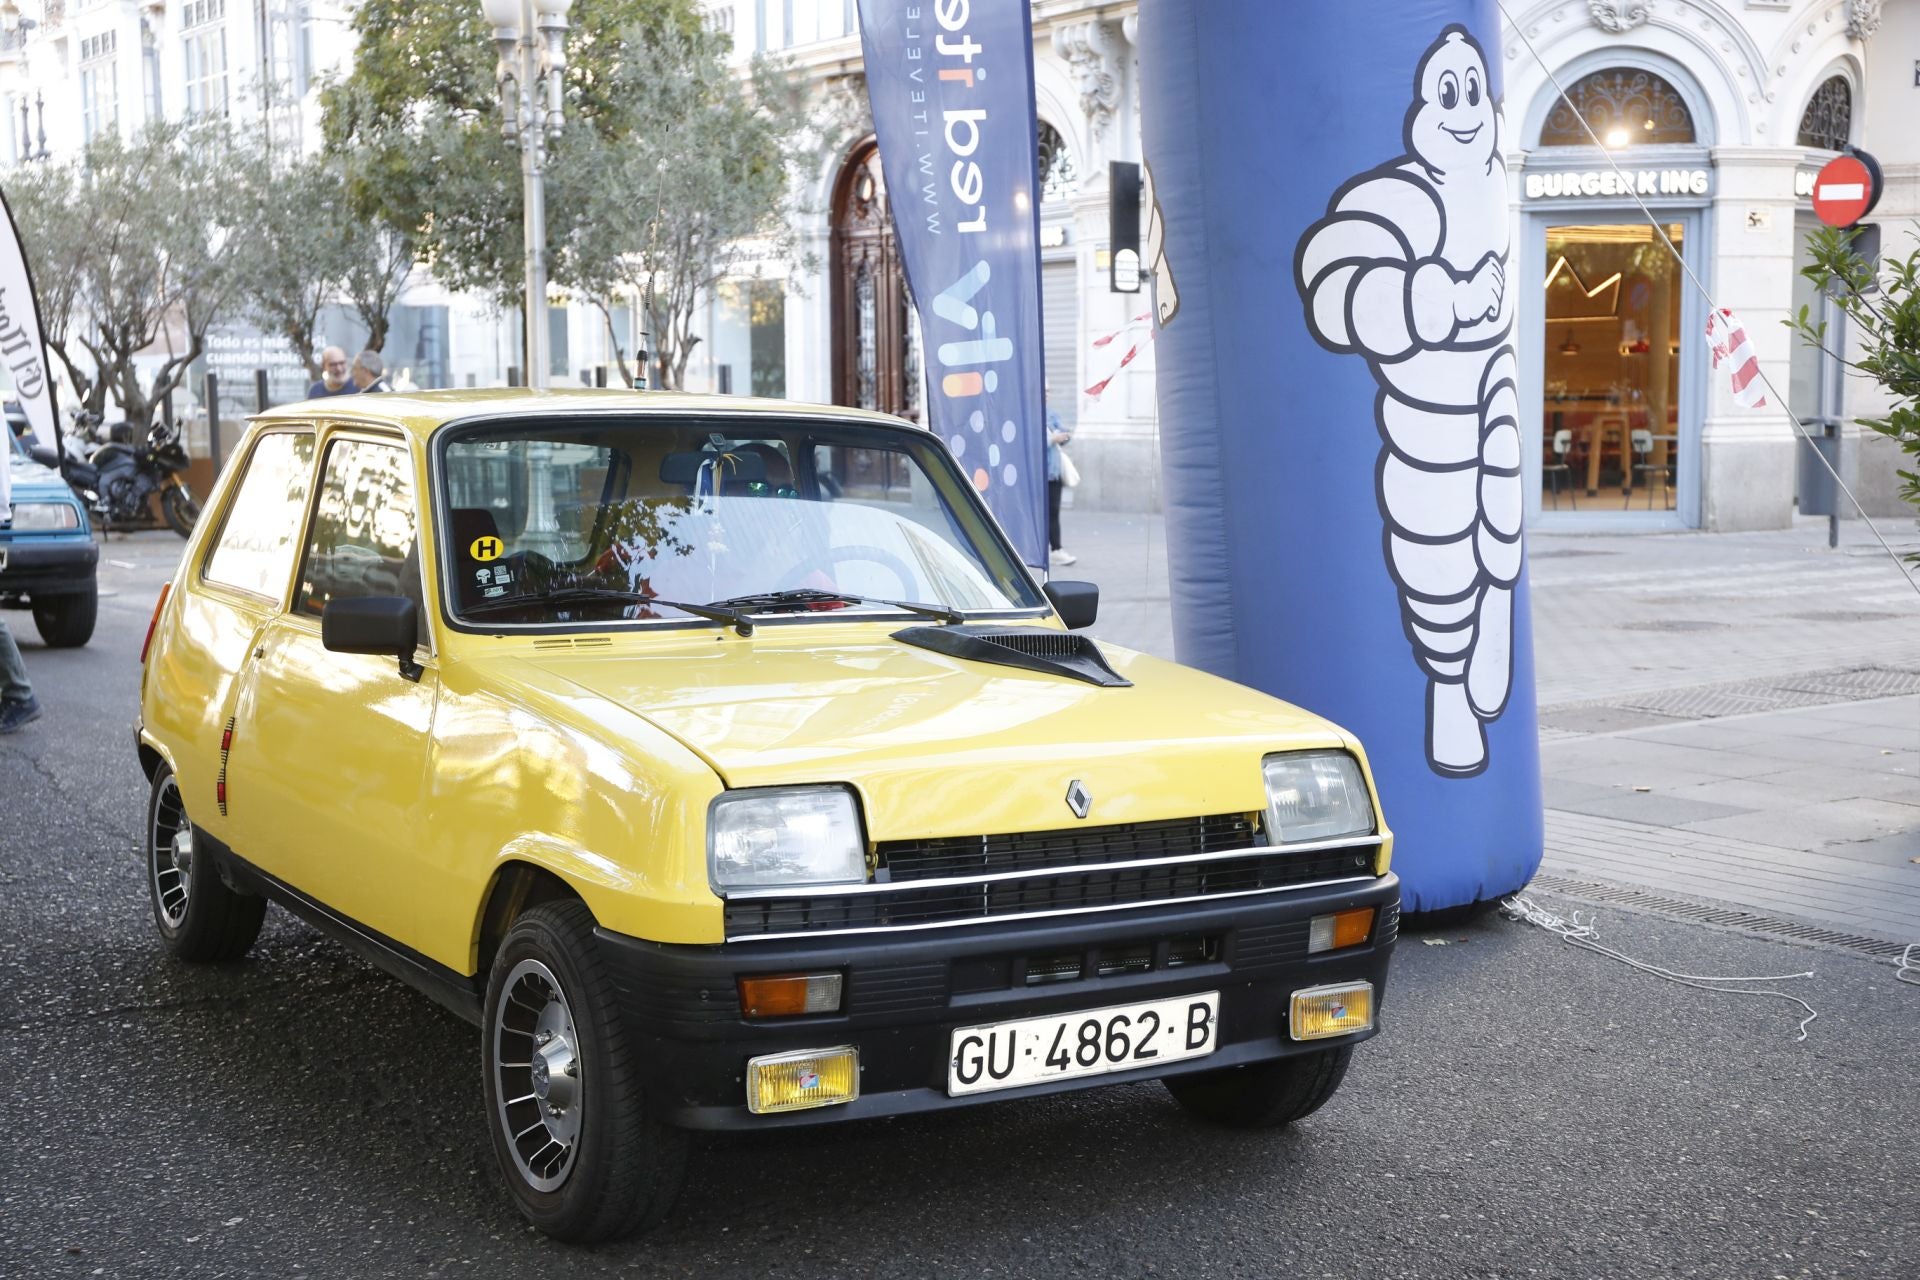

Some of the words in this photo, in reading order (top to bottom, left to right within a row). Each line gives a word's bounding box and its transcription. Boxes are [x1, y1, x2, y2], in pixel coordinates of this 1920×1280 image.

[1526, 171, 1634, 199] BURGER
[1637, 170, 1708, 195] KING
[206, 334, 241, 350] Todo
[243, 336, 260, 350] es
[206, 349, 261, 365] cuando
[478, 539, 496, 558] H
